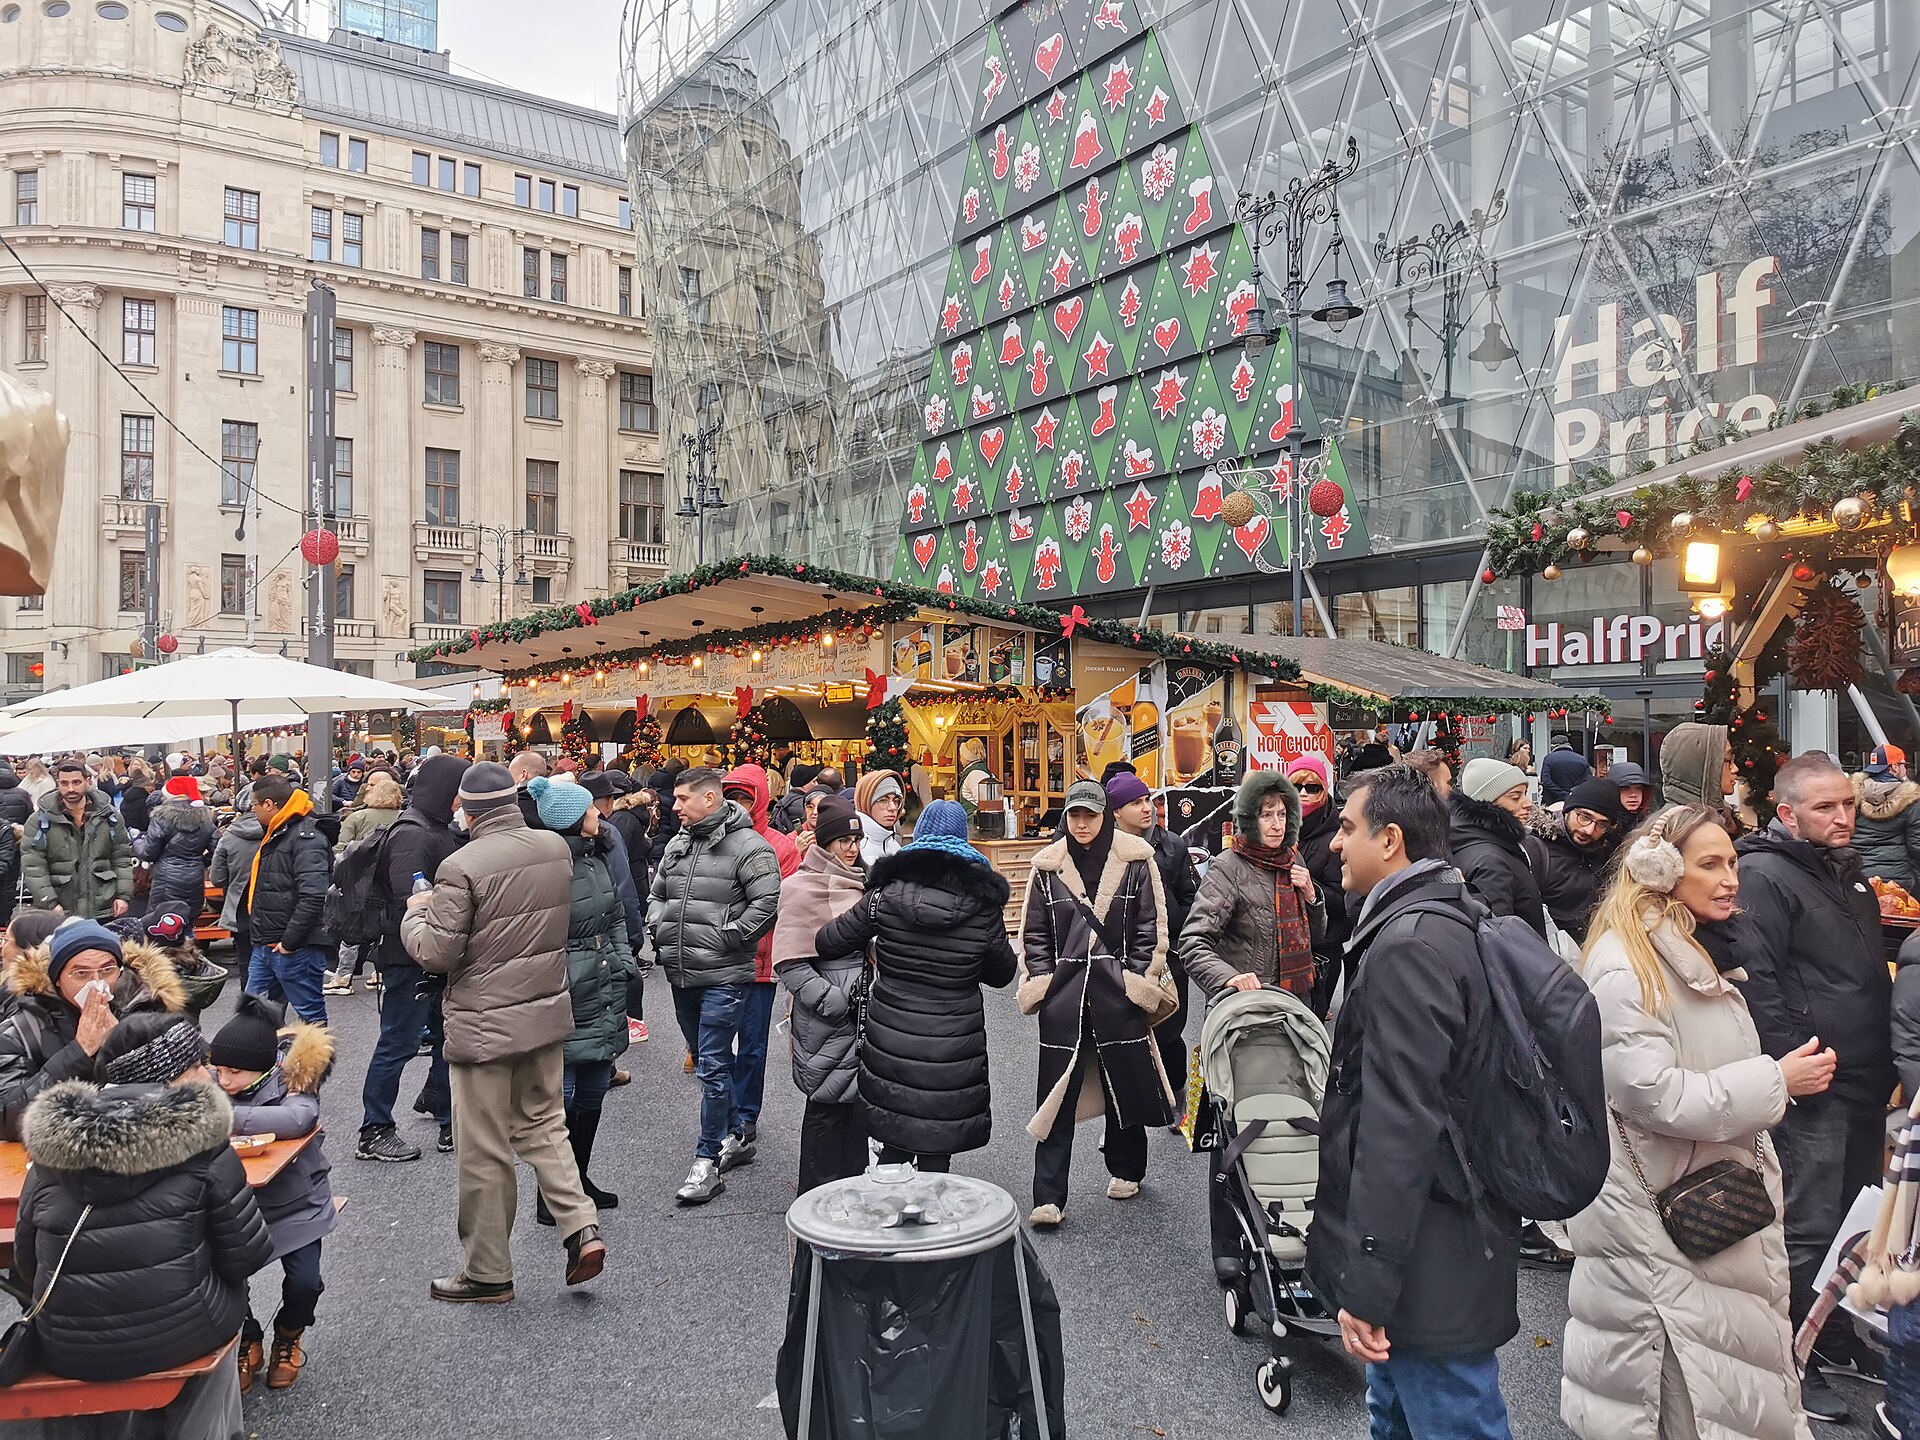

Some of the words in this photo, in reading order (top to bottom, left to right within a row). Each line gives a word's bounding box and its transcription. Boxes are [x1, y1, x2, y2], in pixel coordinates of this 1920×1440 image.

[1554, 256, 1775, 405] Half
[1084, 665, 1105, 673] JOHNNIE
[1106, 665, 1126, 673] WALKER
[1177, 667, 1203, 678] BAILEYS
[1216, 741, 1240, 752] BAILEYS
[1257, 735, 1282, 752] HOT
[1286, 735, 1327, 752] CHOCO
